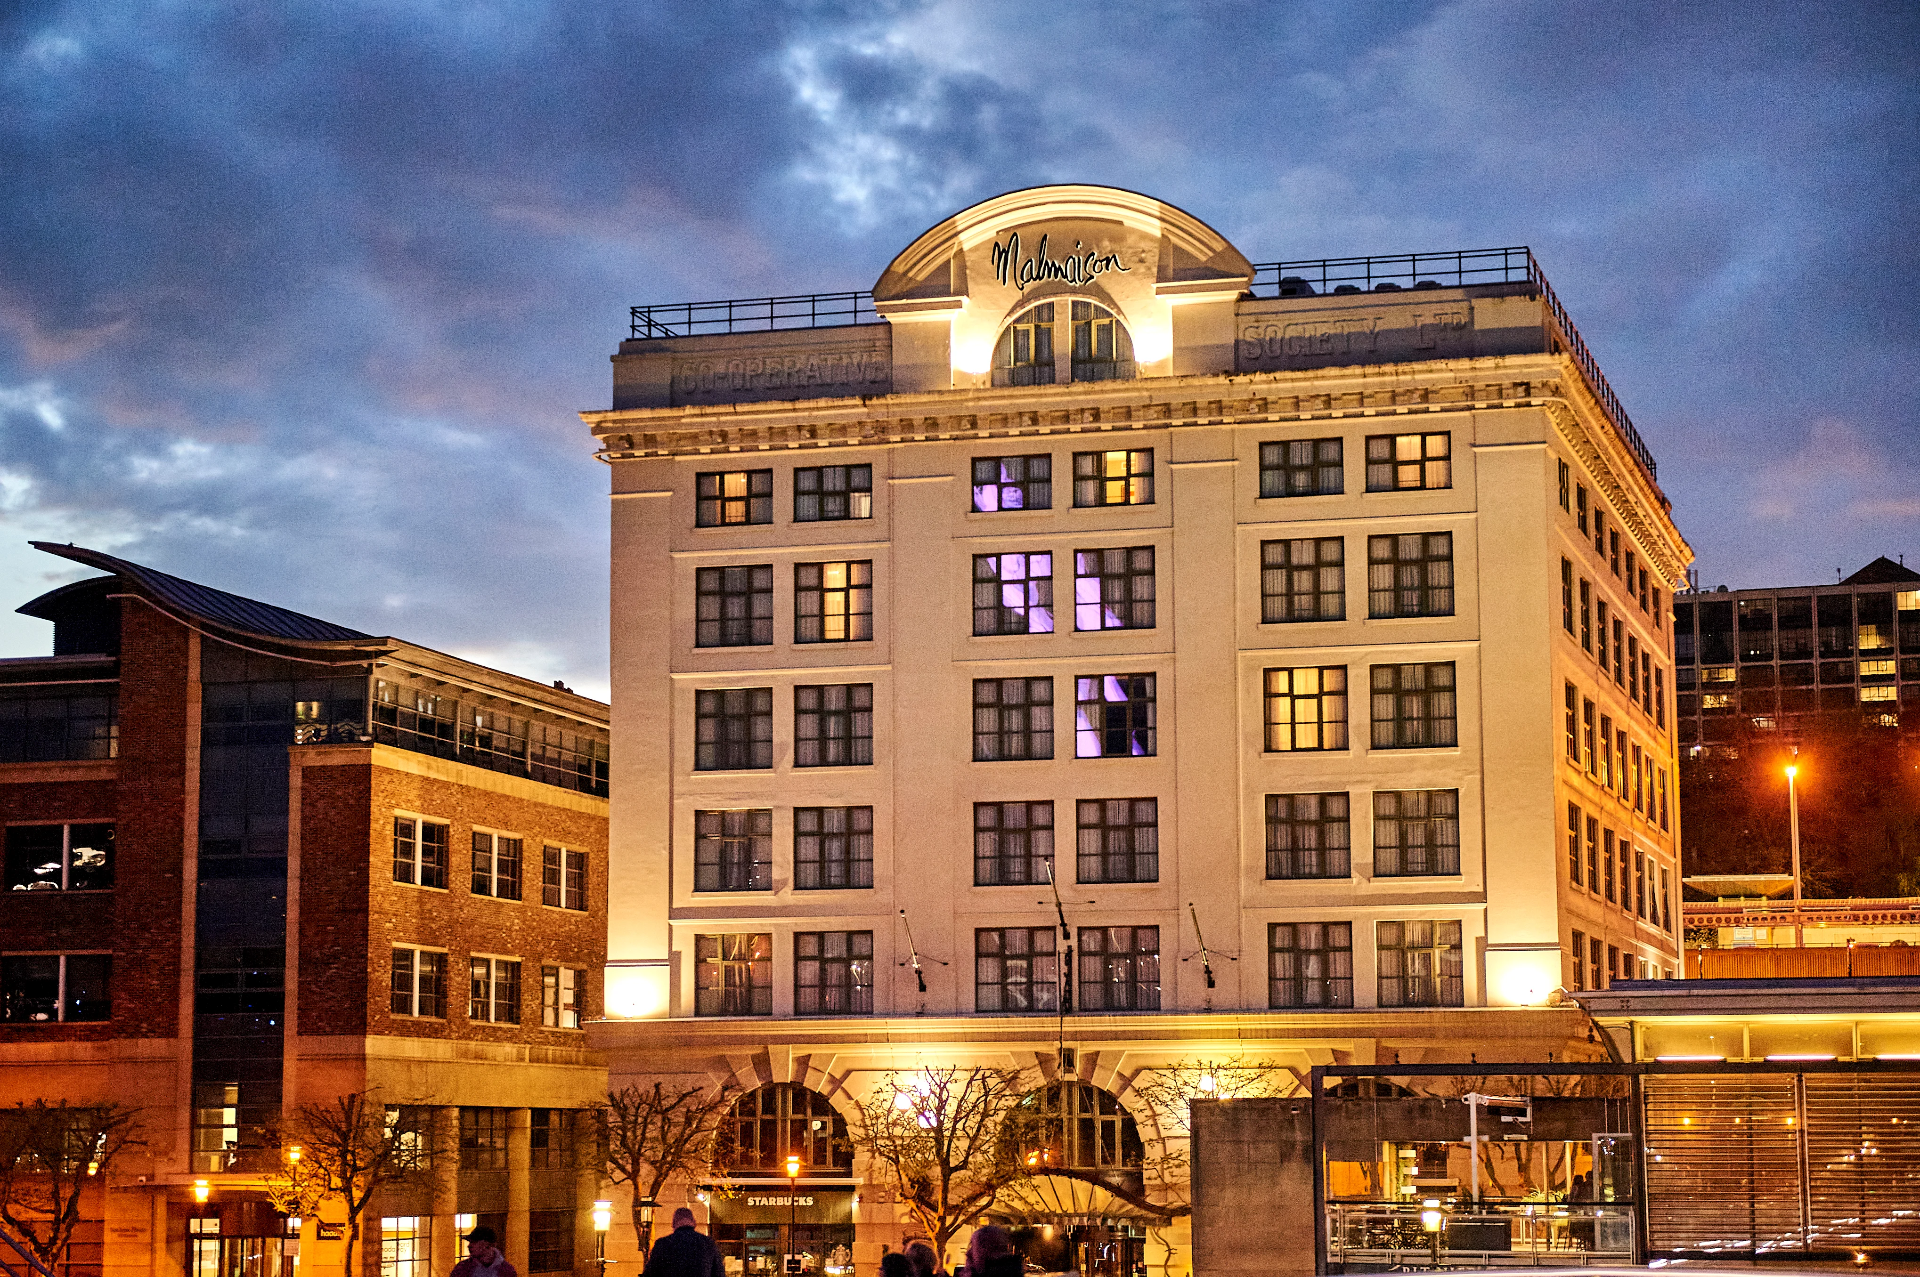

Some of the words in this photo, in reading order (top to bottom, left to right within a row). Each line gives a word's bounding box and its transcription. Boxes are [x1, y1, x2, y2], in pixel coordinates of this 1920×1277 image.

[992, 232, 1132, 291] Malmaison
[1243, 316, 1384, 360] SOCIETY
[680, 352, 889, 396] CO-OPERATIVE
[747, 1196, 814, 1206] STARBUCKS
